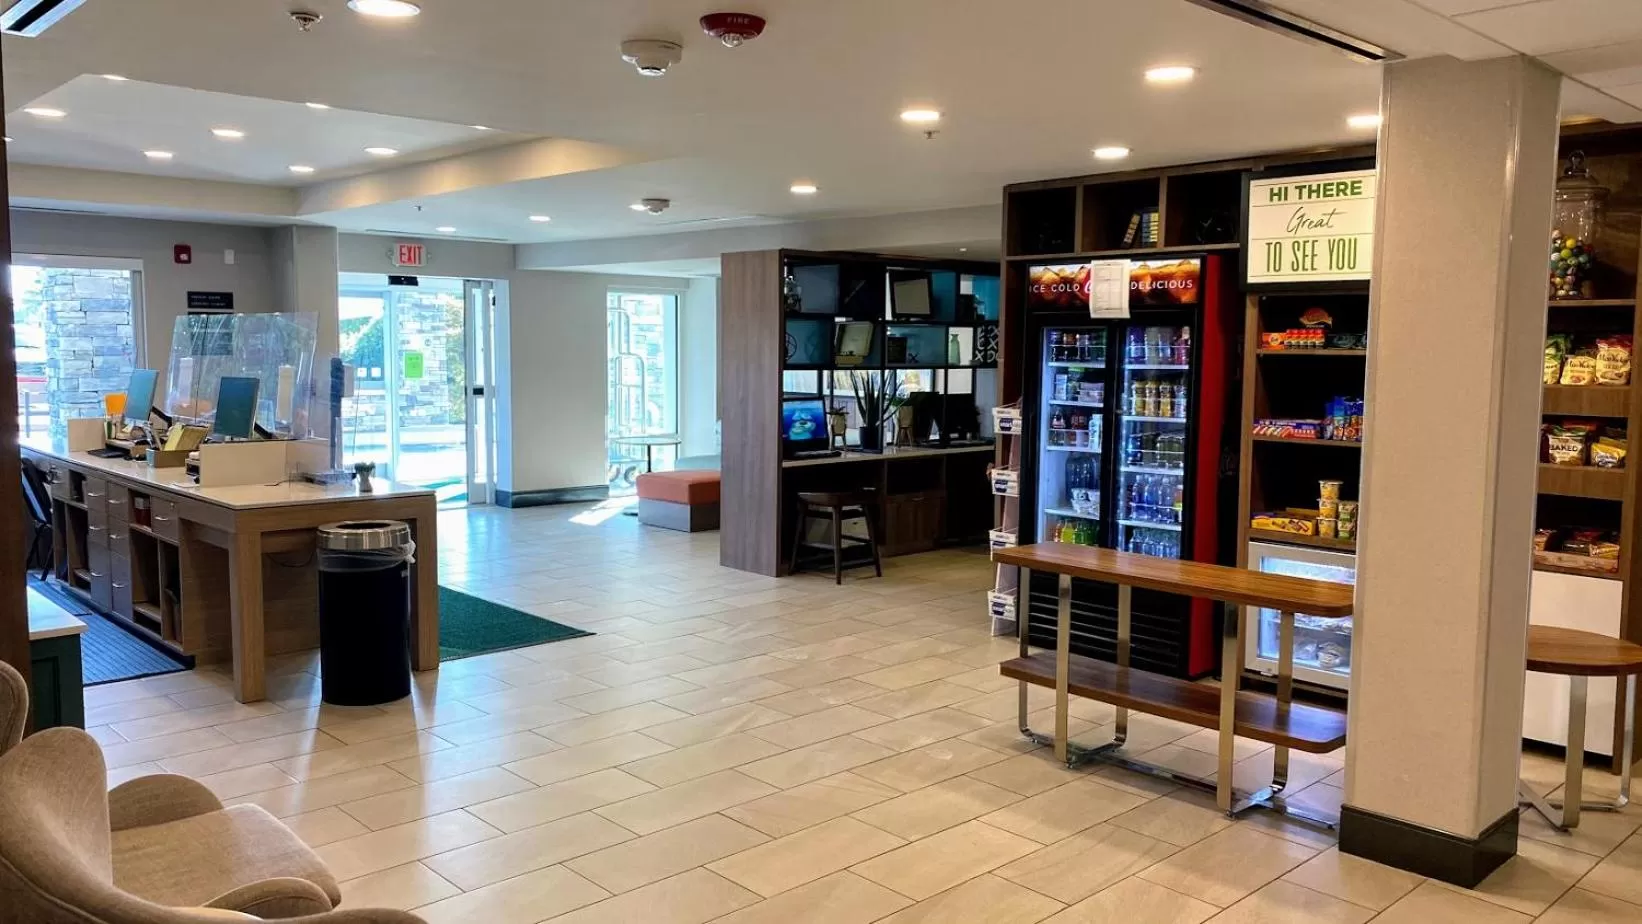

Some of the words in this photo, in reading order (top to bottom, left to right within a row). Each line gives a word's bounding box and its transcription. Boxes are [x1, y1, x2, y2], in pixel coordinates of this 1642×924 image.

[727, 16, 750, 24] FIRE
[1269, 186, 1288, 202] HI
[1294, 180, 1362, 200] THERE
[1286, 206, 1347, 235] Great
[400, 244, 423, 265] EXIT
[1265, 241, 1282, 273] TO
[1291, 239, 1318, 272] SEE
[1328, 237, 1357, 271] YOU
[1029, 284, 1045, 293] ICE
[1051, 283, 1080, 292] COLD
[1130, 279, 1193, 290] DELICIOUS
